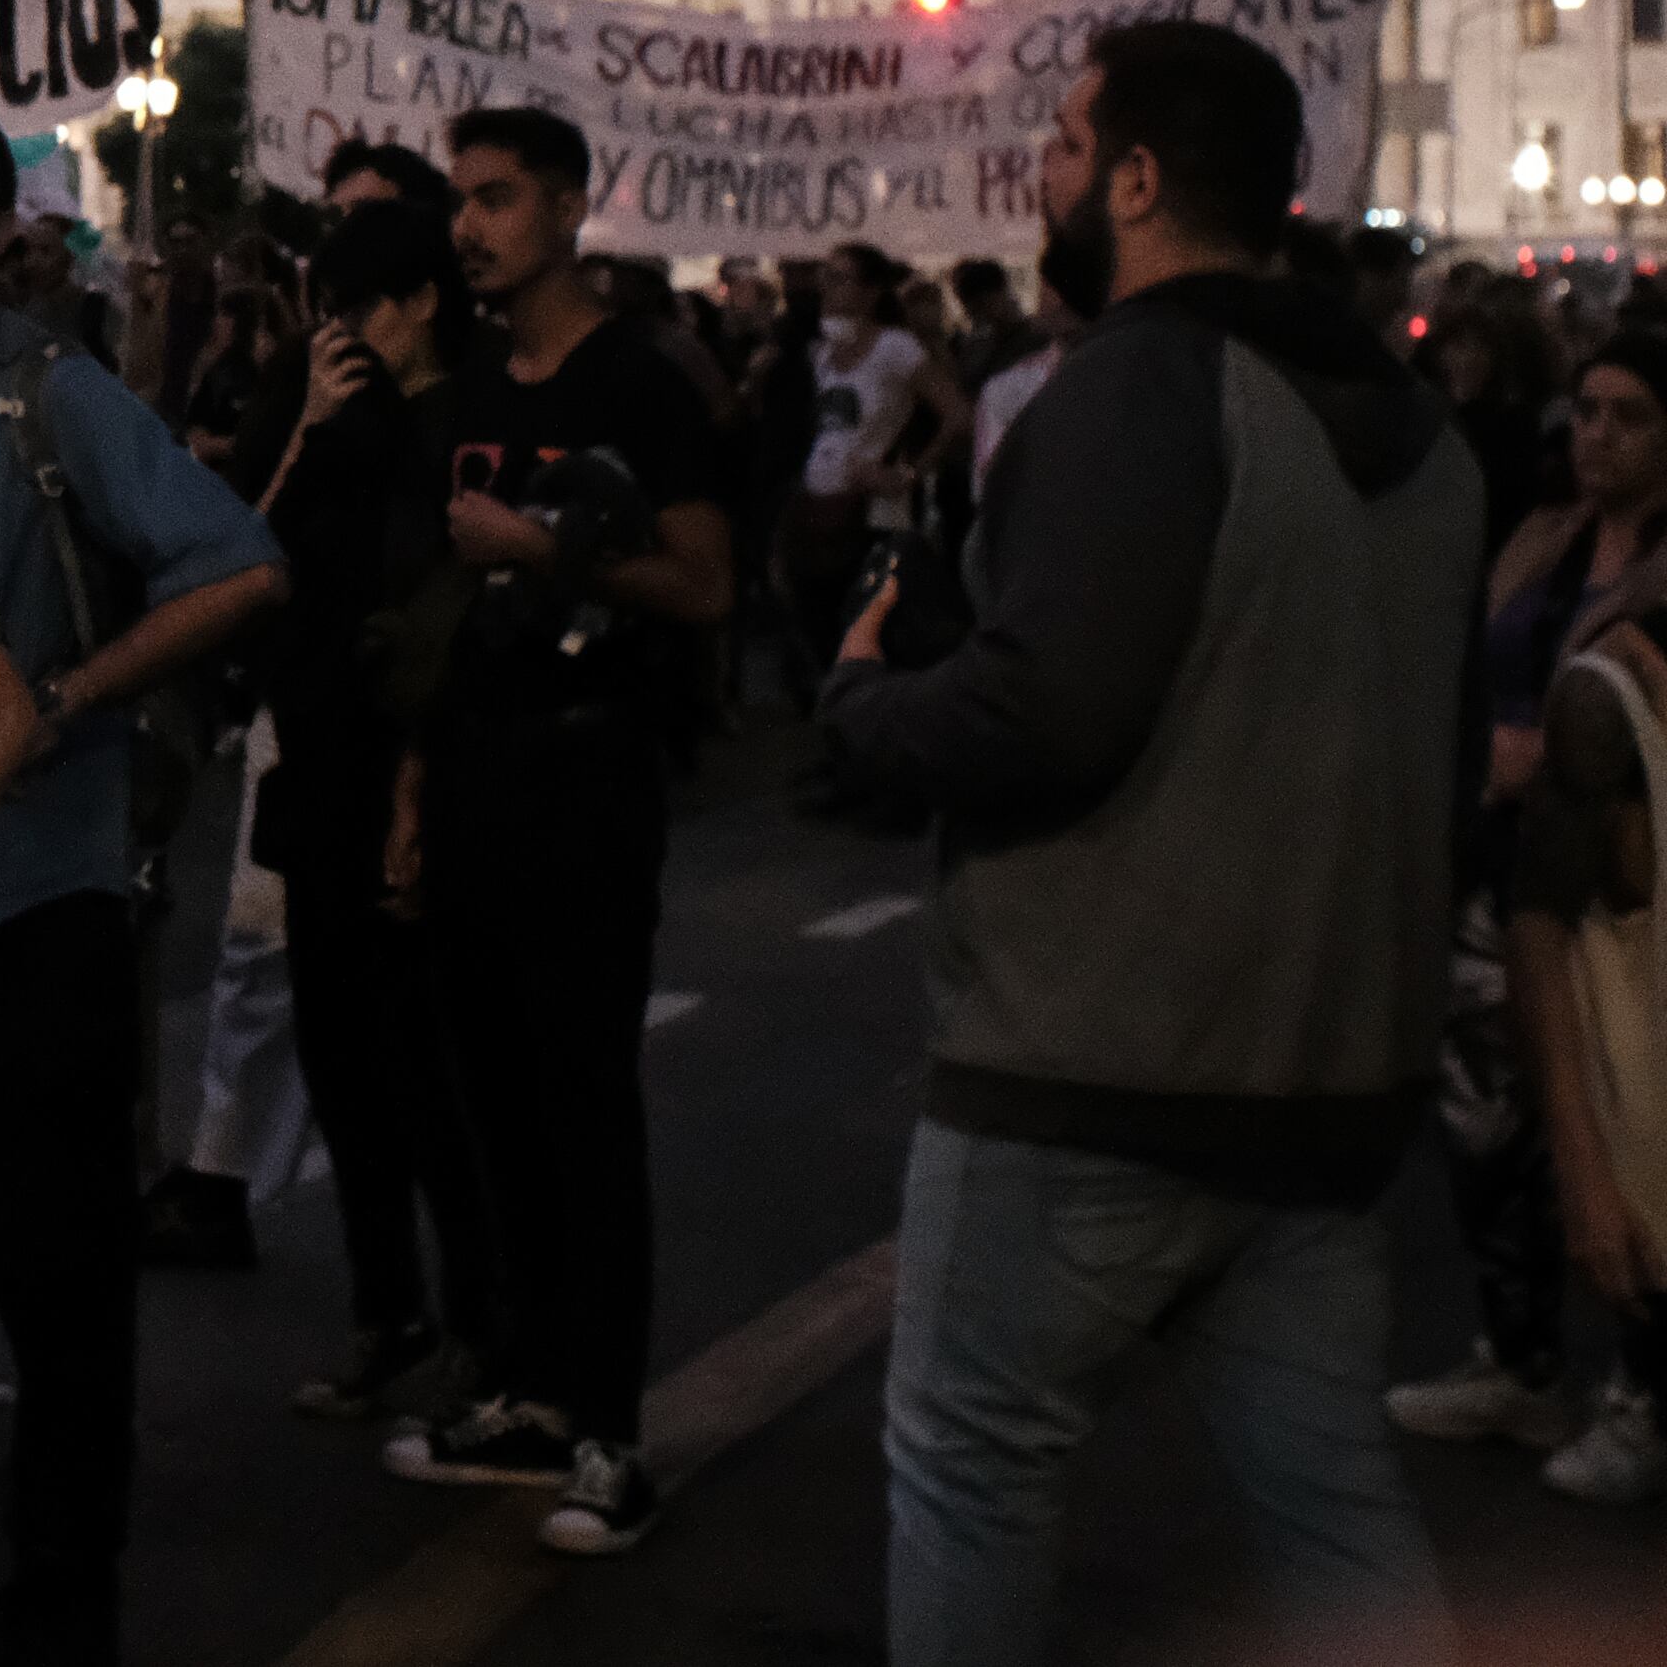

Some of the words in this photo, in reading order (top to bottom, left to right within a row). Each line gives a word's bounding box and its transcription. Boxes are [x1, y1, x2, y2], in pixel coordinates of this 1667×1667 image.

[322, 32, 494, 110] PLAN
[610, 96, 820, 146] LUCHA
[596, 23, 903, 98] SCALABRINI
[642, 149, 867, 232] OMNIBUS
